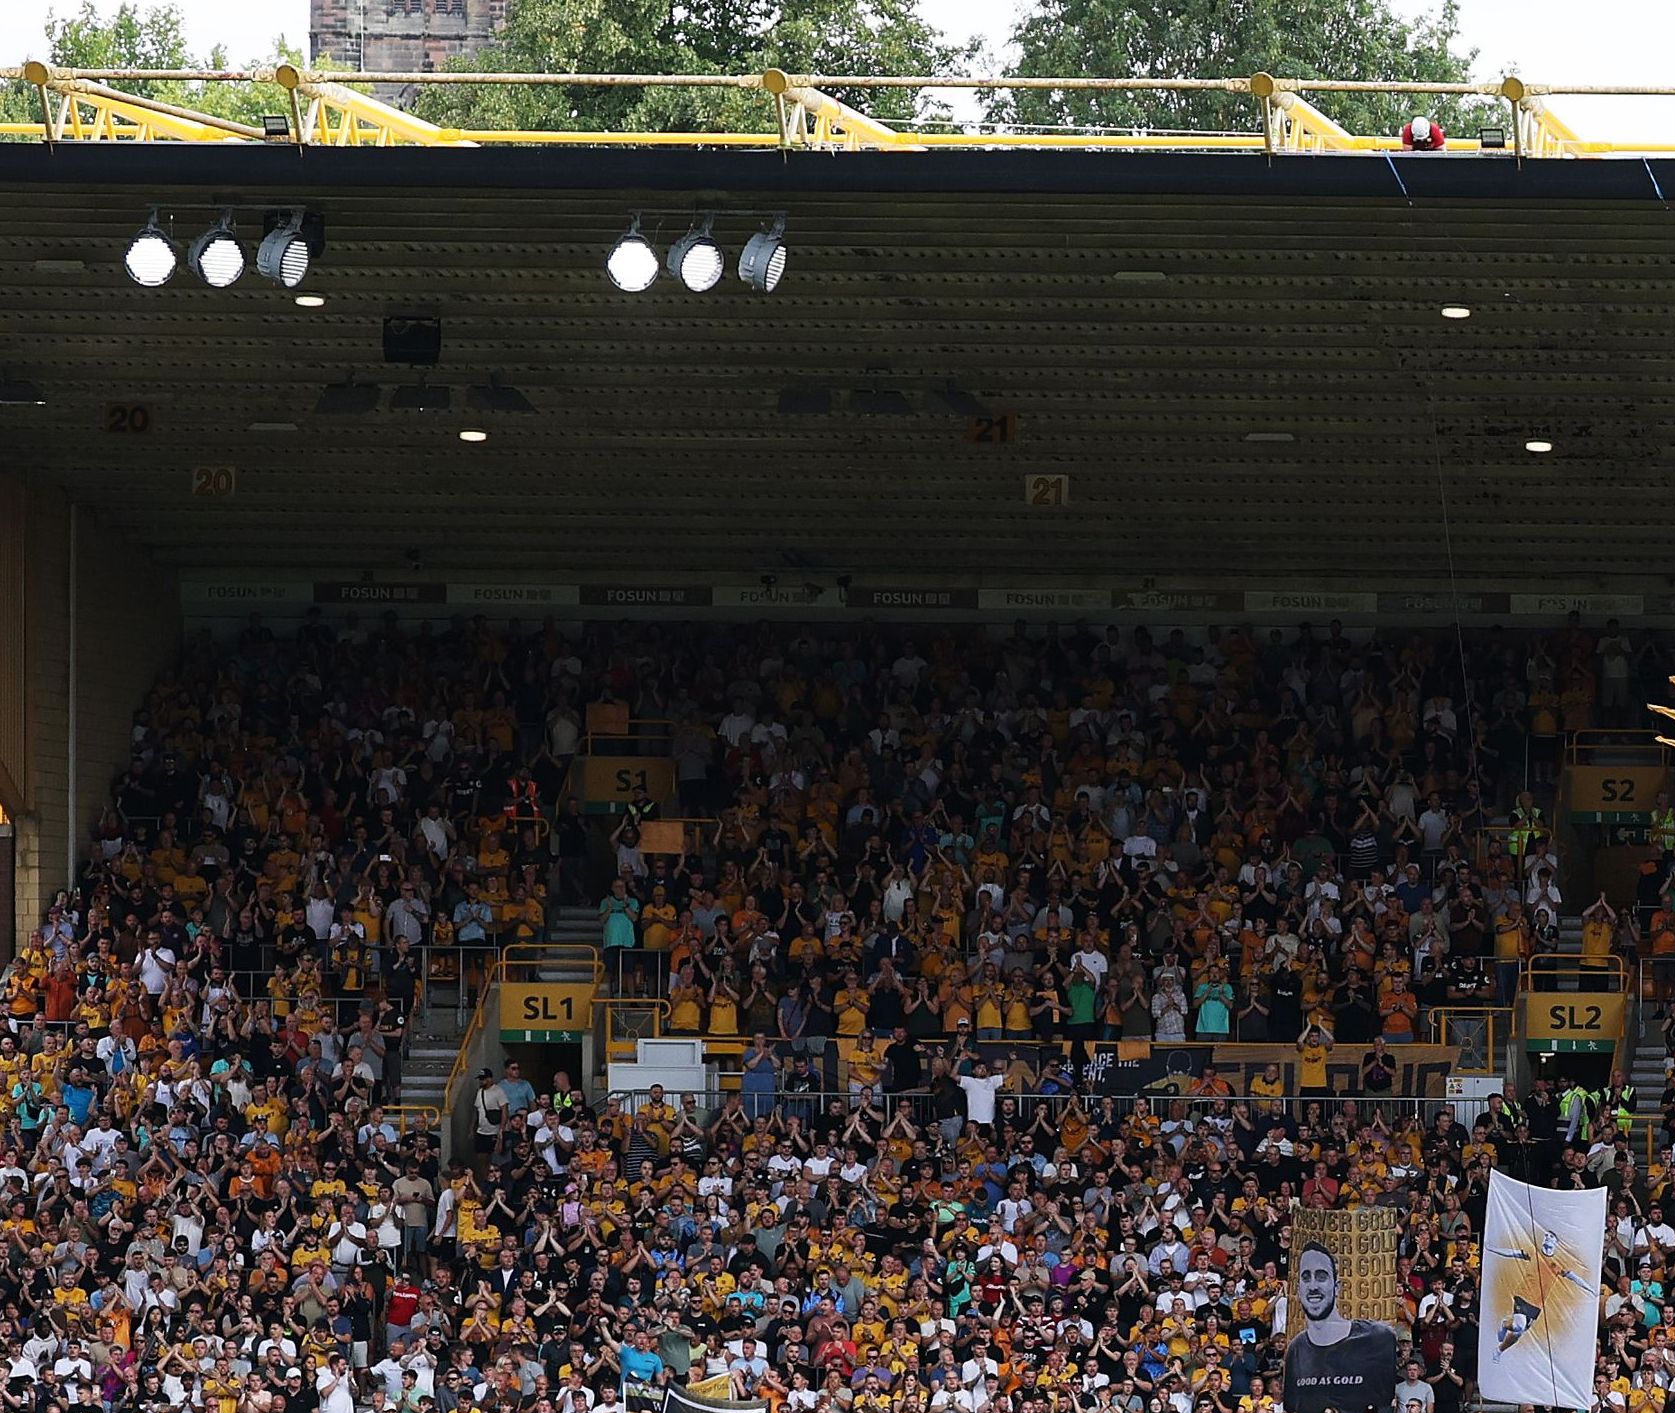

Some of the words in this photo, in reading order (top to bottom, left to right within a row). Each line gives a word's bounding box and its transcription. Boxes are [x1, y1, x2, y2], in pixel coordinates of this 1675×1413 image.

[109, 406, 148, 432] 20
[976, 416, 1007, 442] 21
[196, 469, 232, 496] 20
[1033, 477, 1061, 504] 21
[341, 586, 390, 600] FOSUN
[474, 588, 523, 601] FOSUN
[607, 589, 657, 602] FOSUN
[873, 592, 922, 604] FOSUN
[1006, 593, 1055, 605] FOSUN
[1272, 596, 1321, 607] FOSUN
[616, 770, 647, 792] S1
[1602, 779, 1634, 801] S2
[524, 997, 572, 1020] SL1
[1550, 1005, 1601, 1029] SL2
[1293, 1209, 1352, 1231] OREVER
[1356, 1208, 1397, 1231] GOLD
[1356, 1231, 1397, 1254] GOLD
[1356, 1255, 1397, 1277] GOLD
[1356, 1277, 1397, 1300] GOLD
[1356, 1300, 1398, 1321] GOLD
[1296, 1375, 1318, 1387] GOOD
[1319, 1375, 1332, 1386] AS
[1333, 1374, 1364, 1386] GOLD
